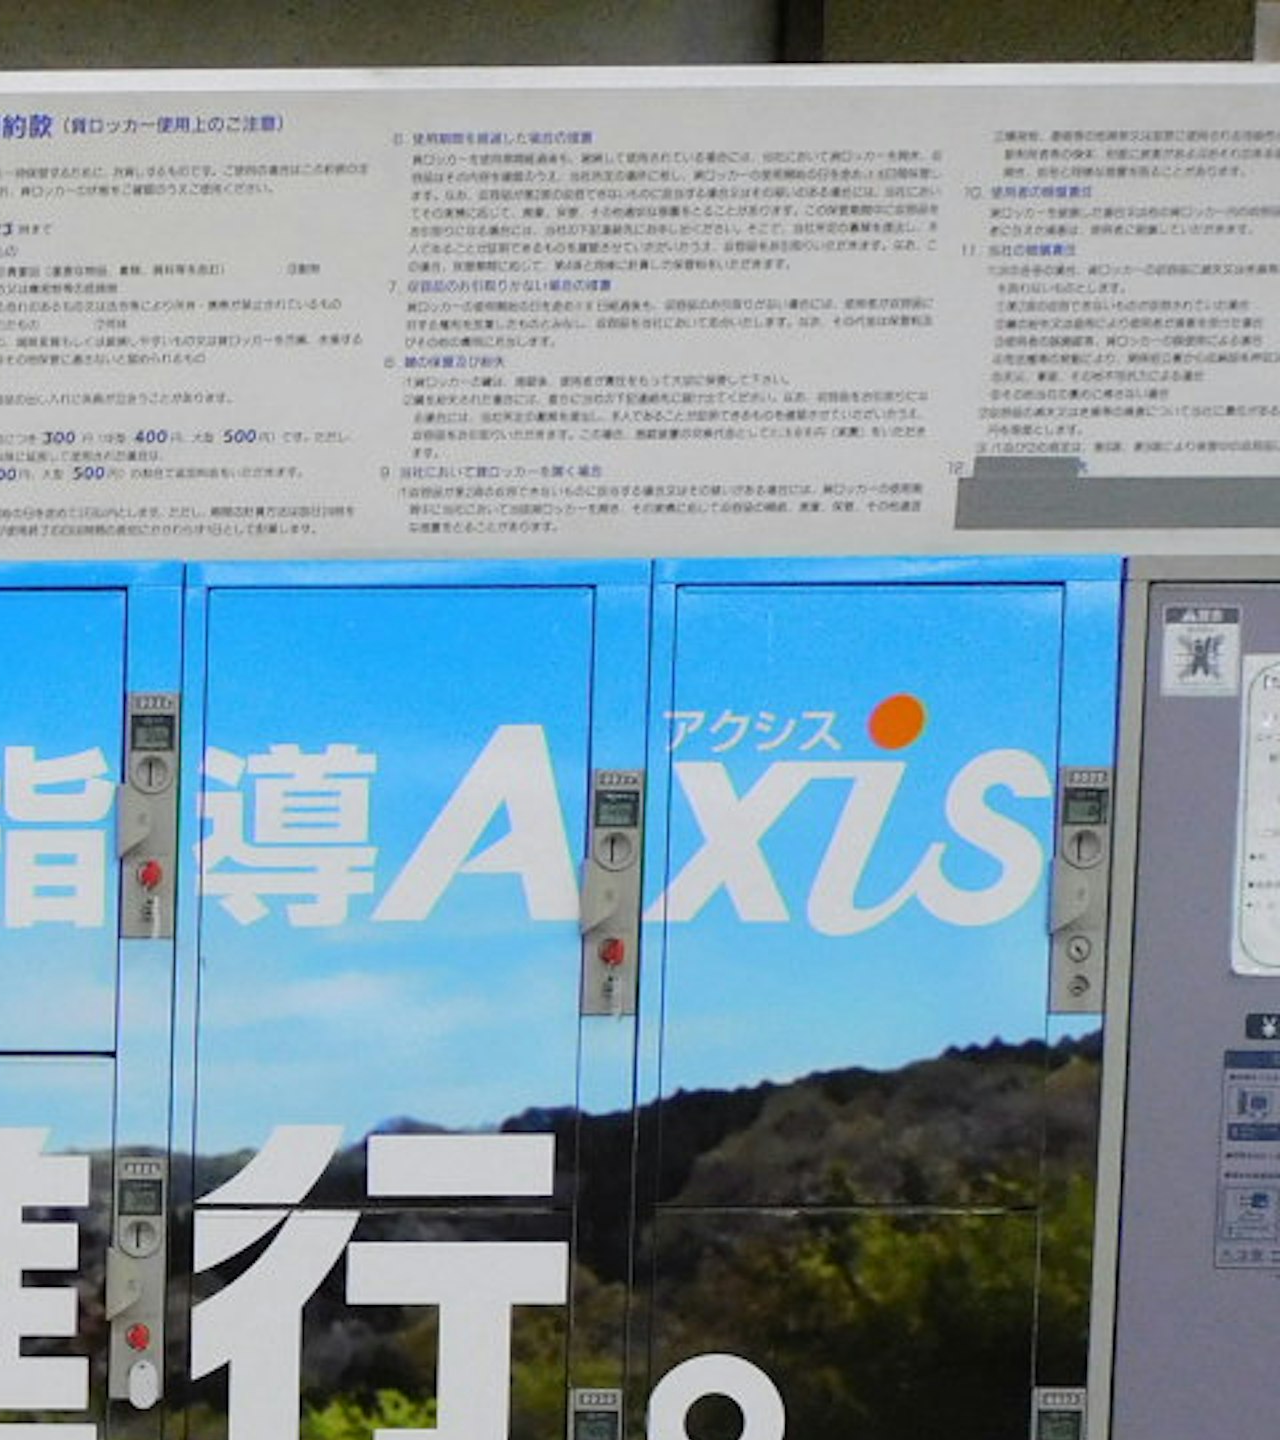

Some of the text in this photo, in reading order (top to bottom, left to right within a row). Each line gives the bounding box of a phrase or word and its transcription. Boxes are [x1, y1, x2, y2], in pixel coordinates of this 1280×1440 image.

[134, 428, 169, 443] 400
[223, 428, 257, 443] 500
[72, 466, 106, 481] 500
[666, 709, 842, 752] アクシス
[370, 696, 1054, 936] Axis
